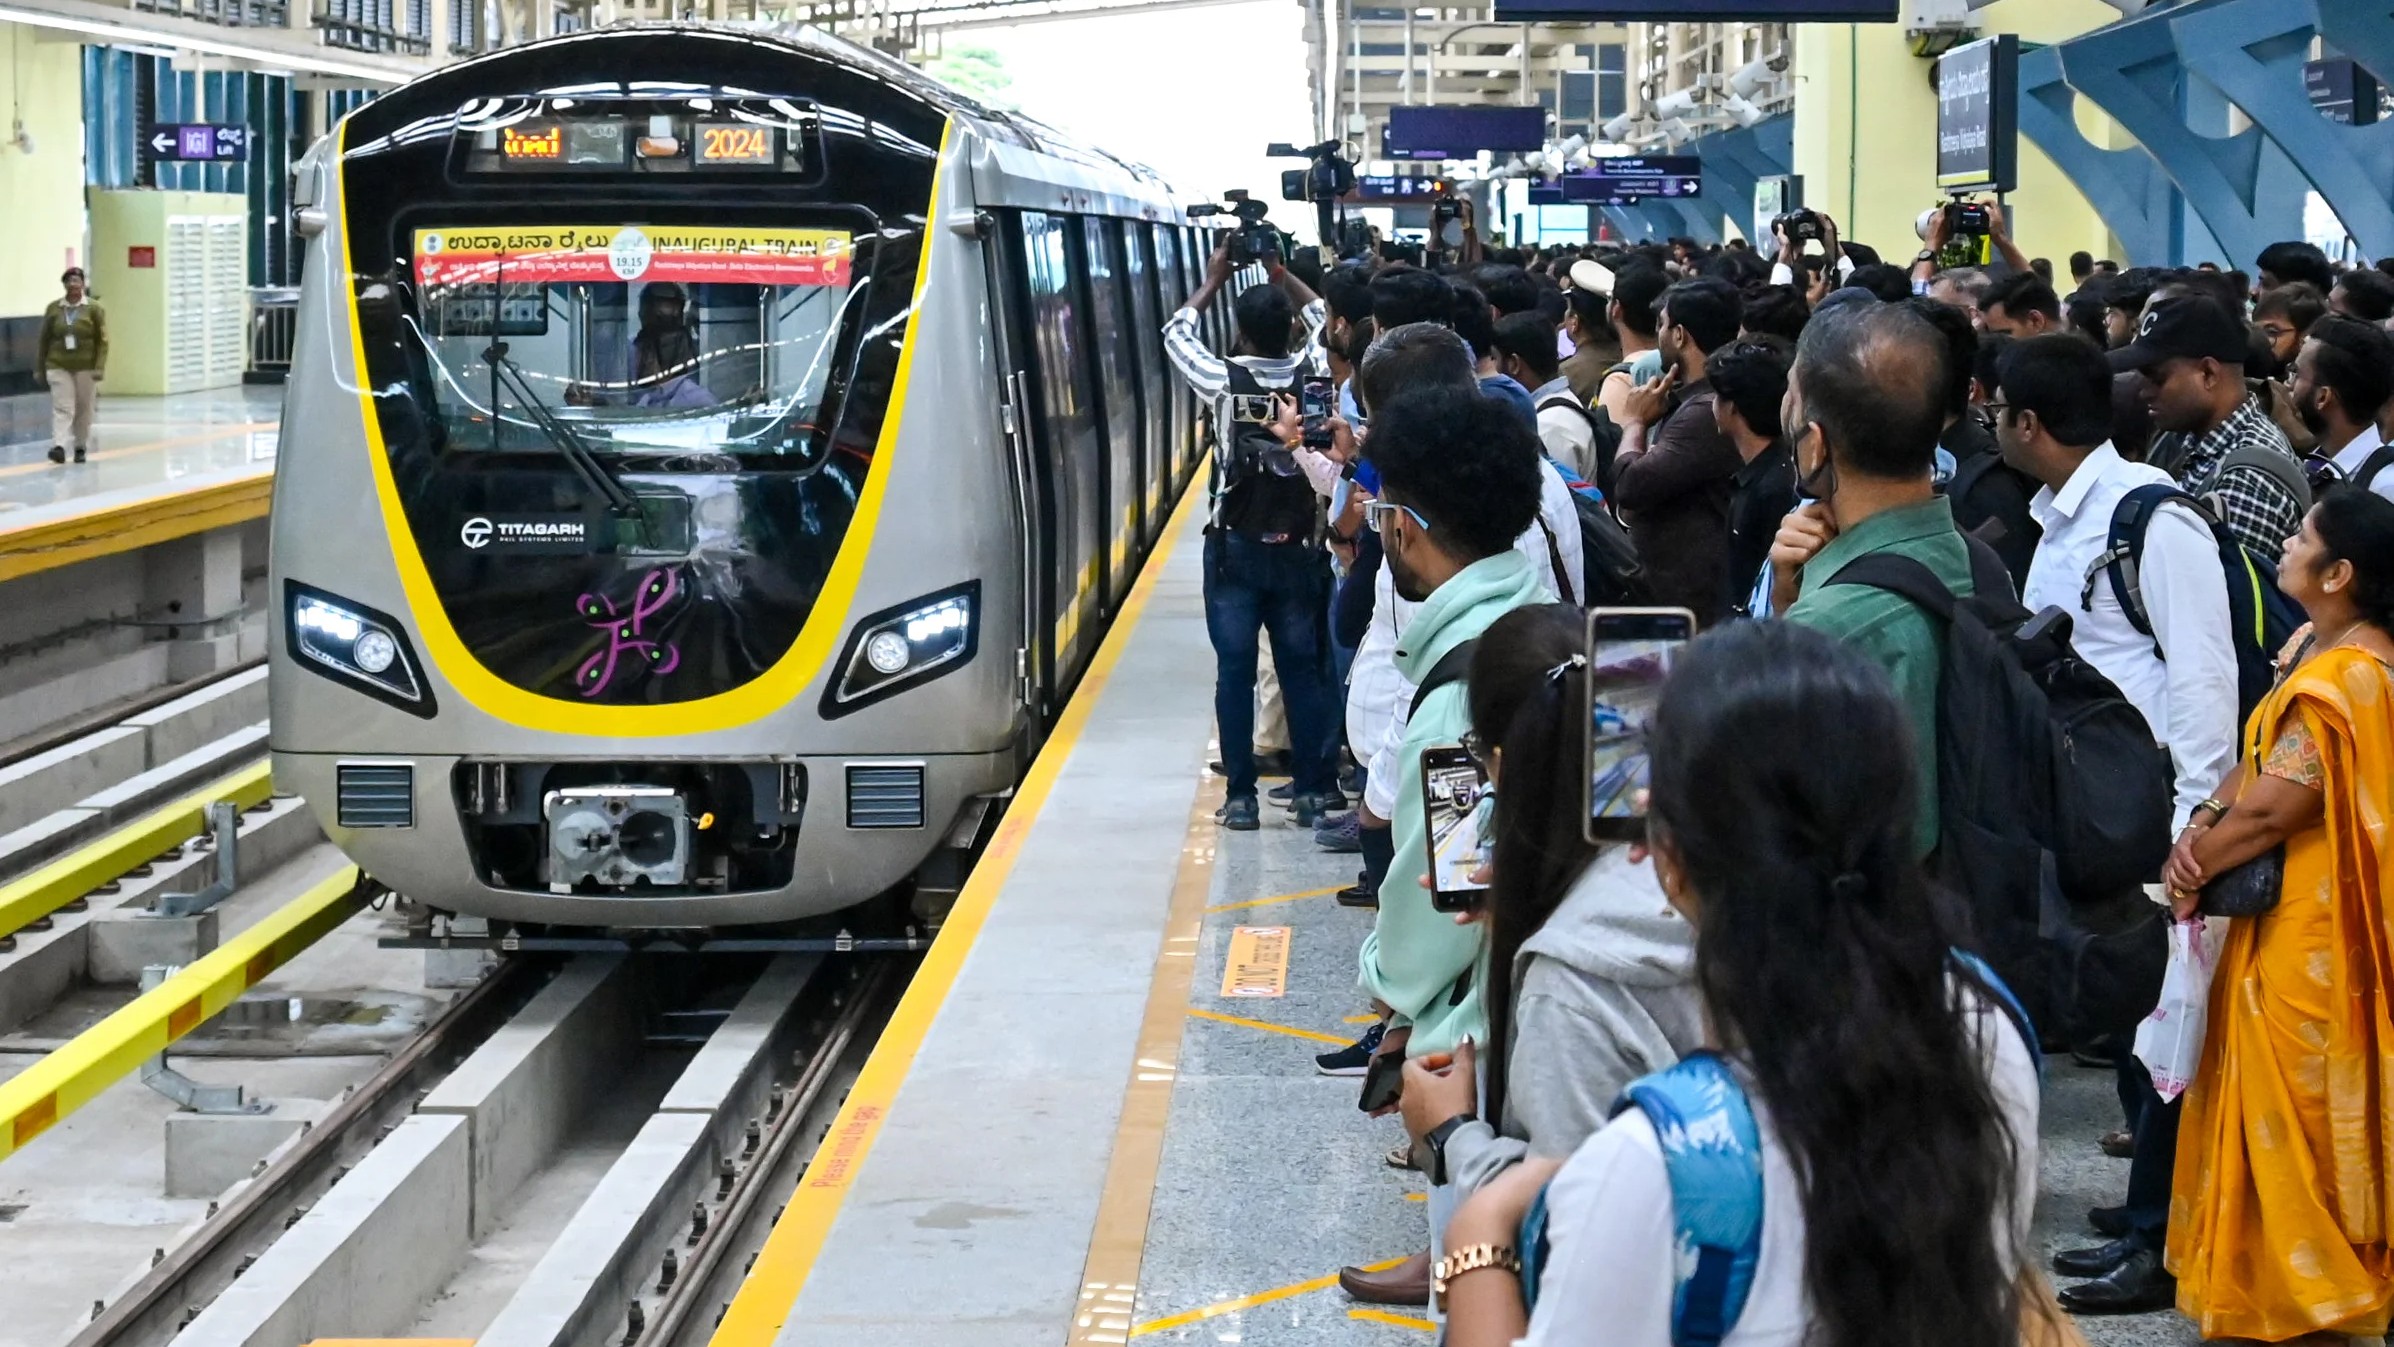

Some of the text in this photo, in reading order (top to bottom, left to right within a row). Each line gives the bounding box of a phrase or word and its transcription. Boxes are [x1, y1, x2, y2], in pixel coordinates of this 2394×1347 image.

[704, 128, 766, 158] 2024
[653, 236, 818, 255] INAUGURAL TRAIN
[616, 257, 643, 267] 19.15
[498, 523, 585, 535] TITAGARH
